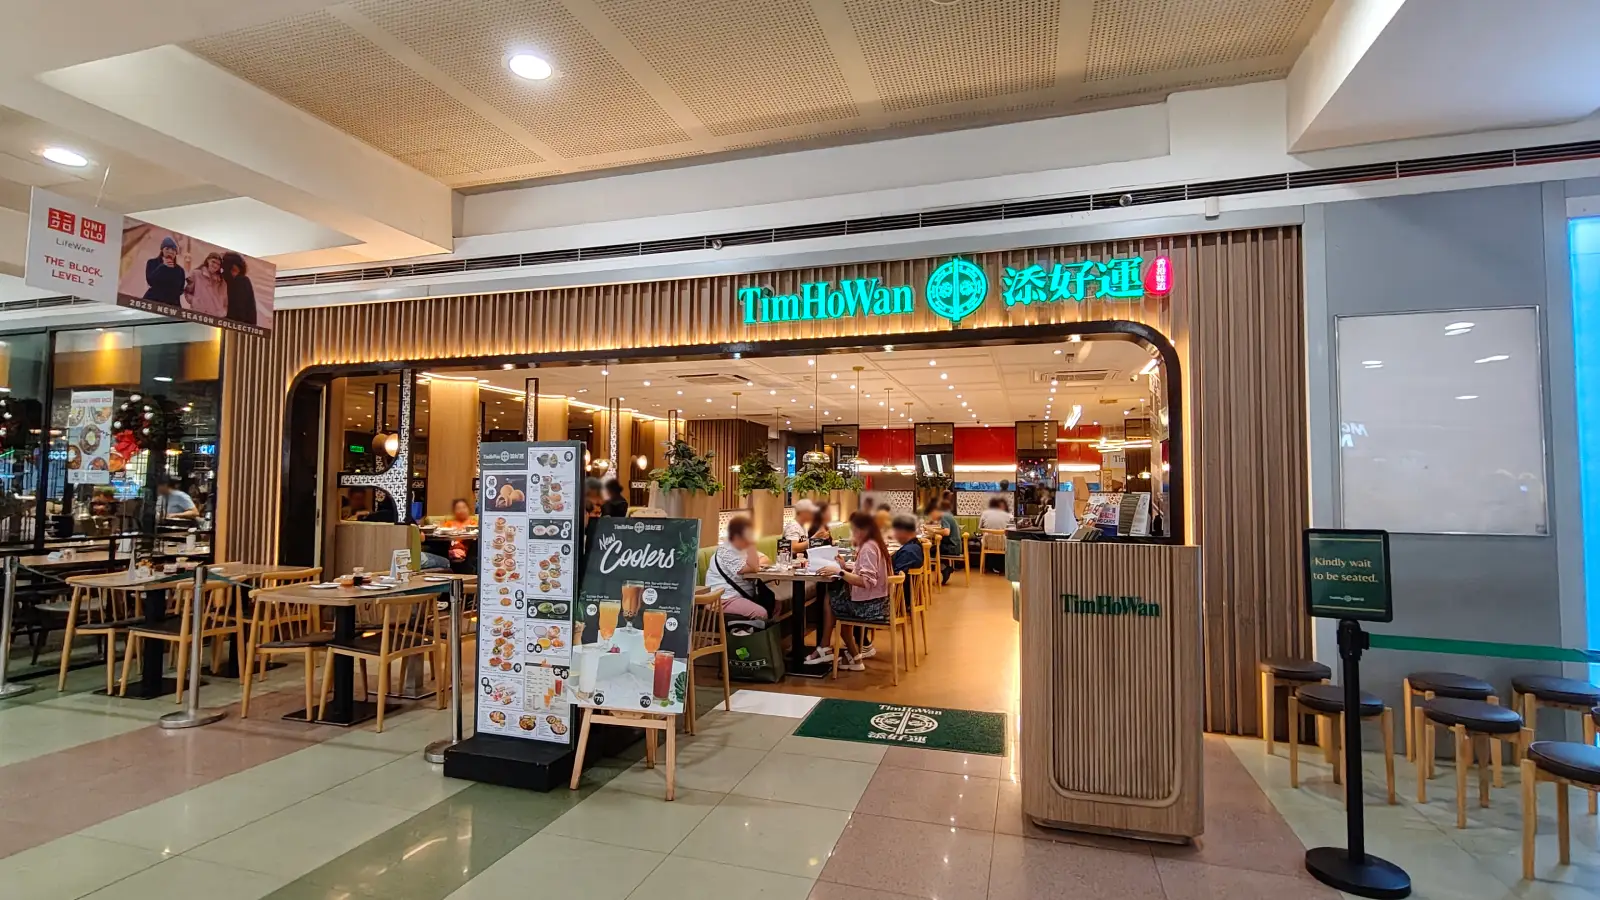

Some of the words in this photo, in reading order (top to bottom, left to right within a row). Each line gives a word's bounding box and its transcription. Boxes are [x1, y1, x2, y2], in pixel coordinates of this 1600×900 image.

[56, 237, 95, 253] LifeWear
[44, 254, 65, 267] THE
[51, 268, 85, 284] LEVEL
[88, 278, 95, 286] 2
[1002, 256, 1145, 306] 添好運
[737, 277, 915, 325] TimHoWan
[129, 299, 153, 310] 2025
[156, 305, 178, 316] NEW
[181, 311, 214, 325] SEASON
[217, 320, 264, 336] COLLECTION
[598, 533, 616, 551] New
[600, 540, 676, 574] Coolers
[1314, 556, 1346, 568] Kindly
[1349, 559, 1372, 568] wait
[1313, 572, 1324, 580] to
[1326, 571, 1339, 581] be
[1341, 573, 1379, 583] seated.
[1060, 594, 1160, 617] TimHoWan
[878, 704, 943, 716] TimHoWan
